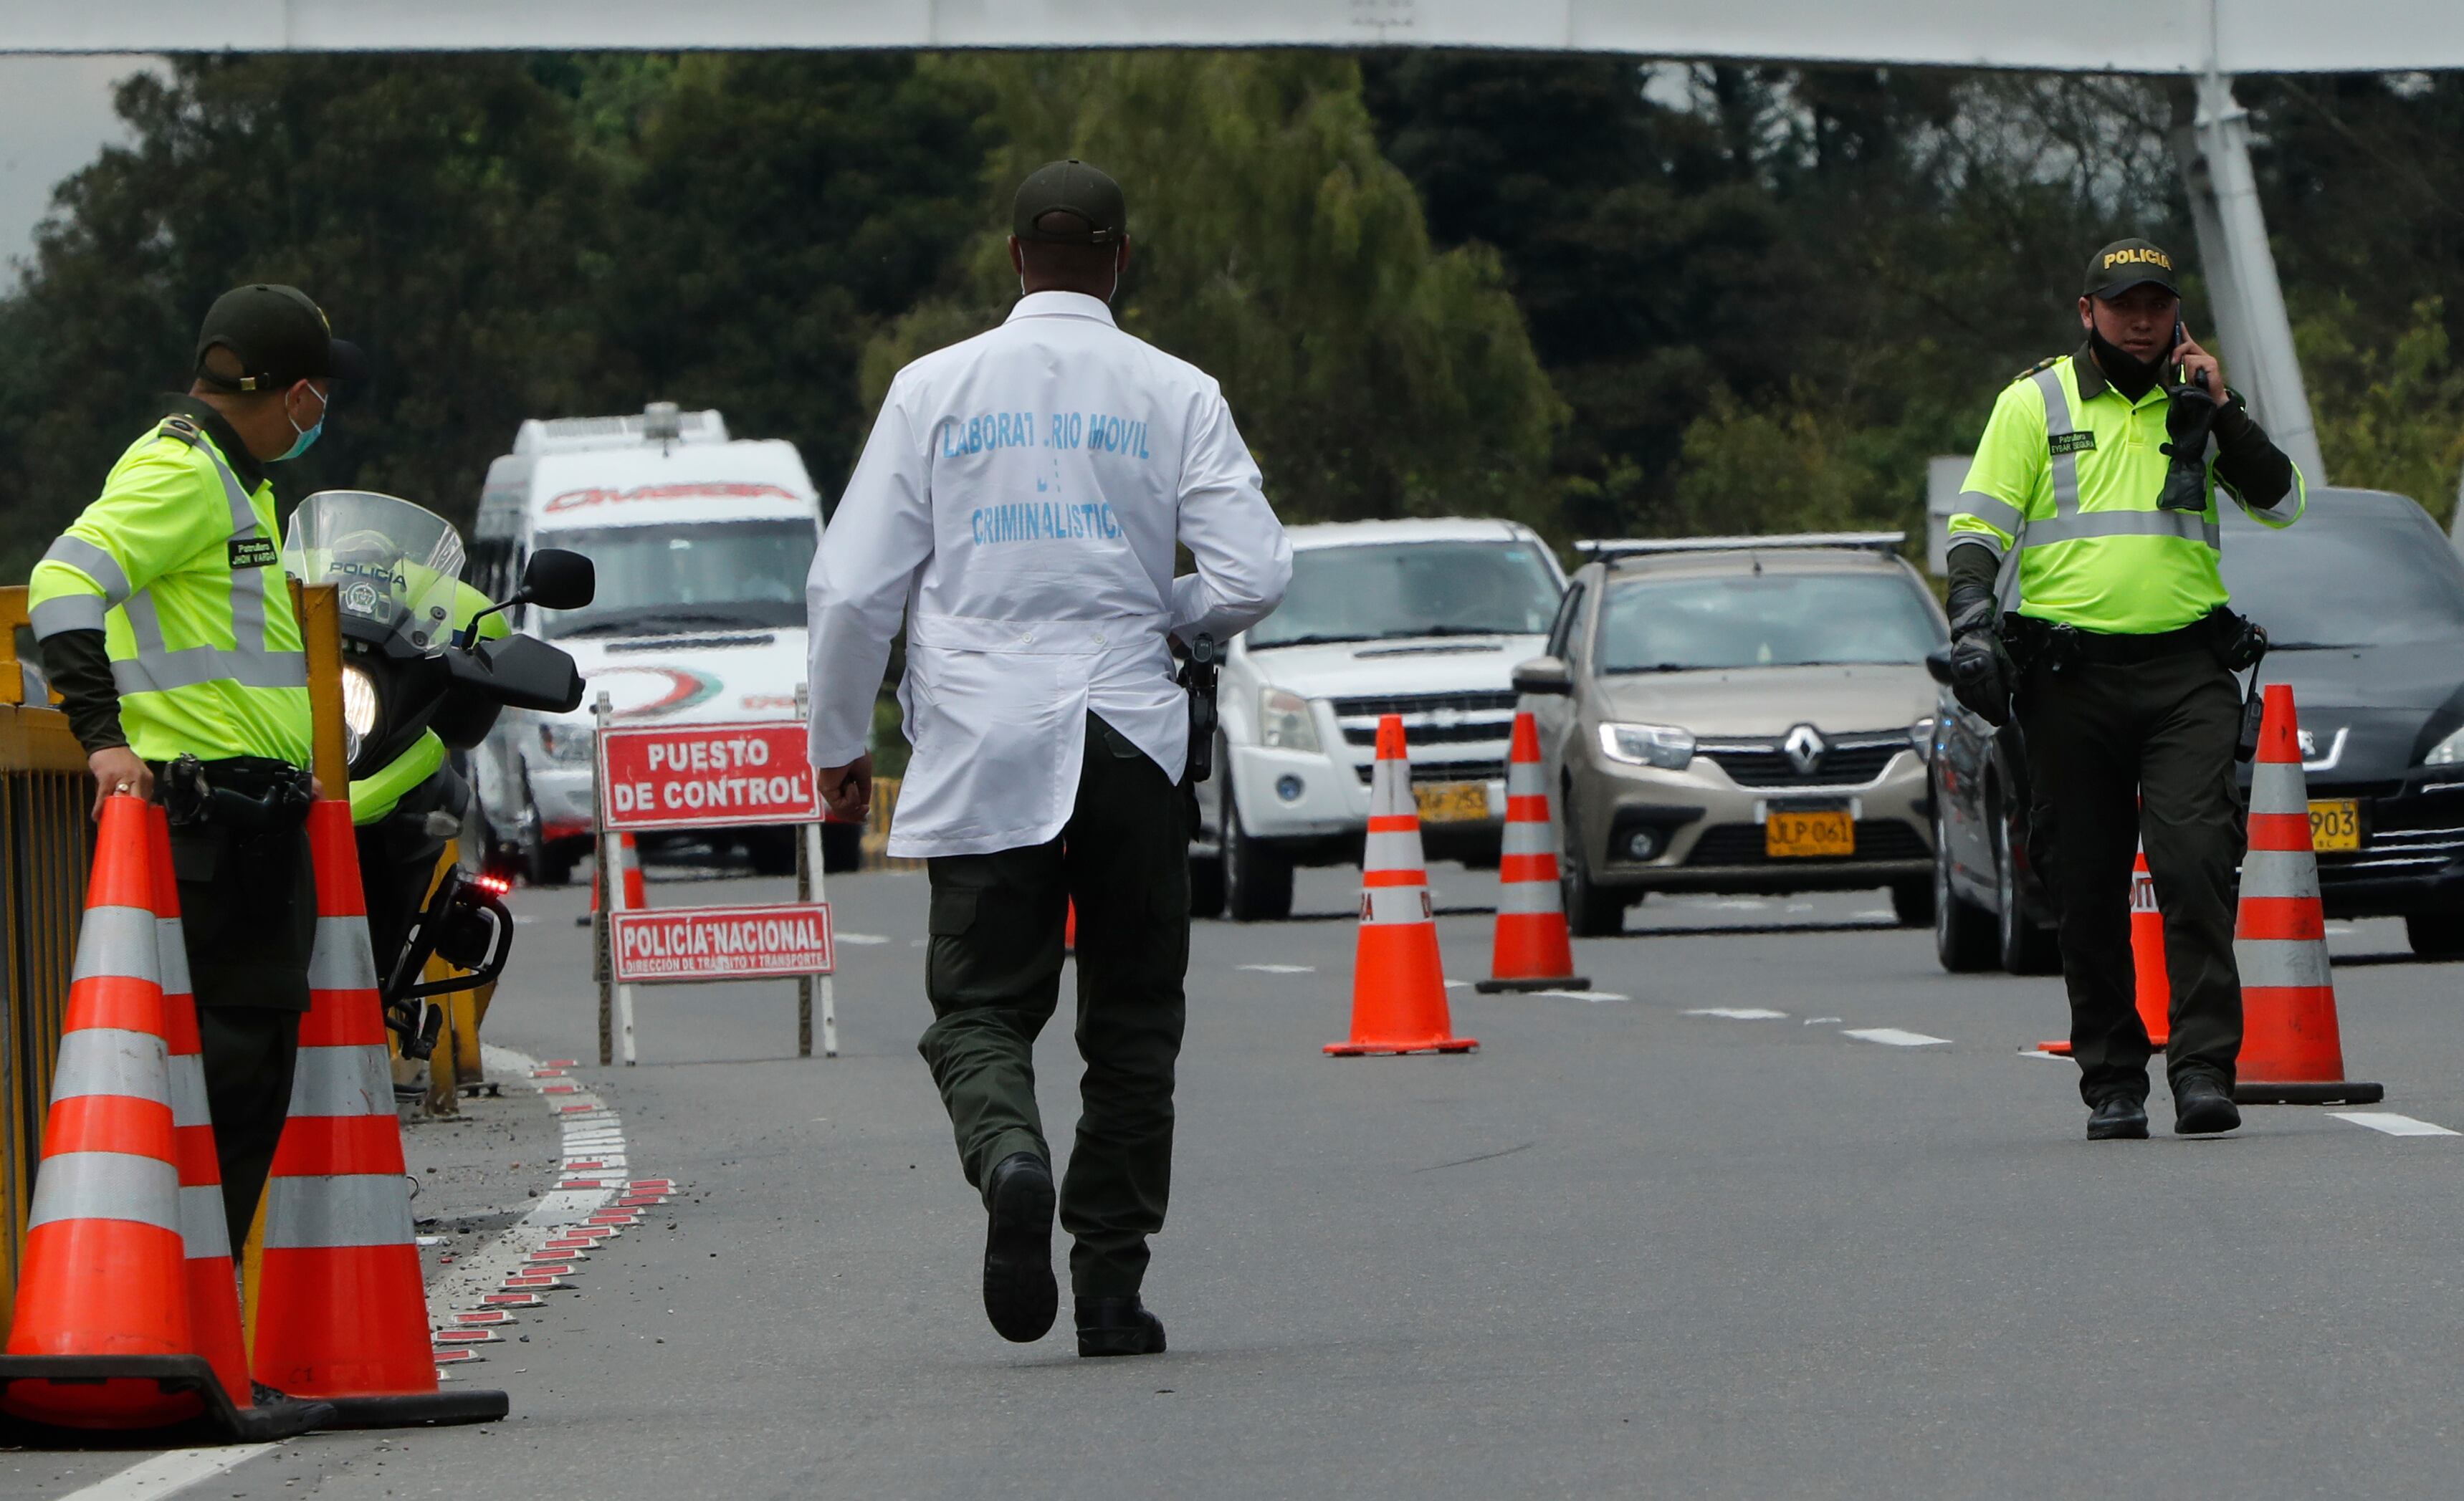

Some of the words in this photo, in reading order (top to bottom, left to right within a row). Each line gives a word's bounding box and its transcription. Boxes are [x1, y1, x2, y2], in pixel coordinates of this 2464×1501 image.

[2104, 249, 2172, 271] POLICIA
[943, 411, 1082, 459] LABORATRIO
[1089, 413, 1150, 459] MOVIL
[972, 502, 1124, 546] CRIMINALISTIC
[648, 738, 769, 771] PUESTO
[614, 782, 654, 812] DE
[663, 776, 809, 809] CONTROL
[2310, 811, 2354, 837] 903
[623, 917, 709, 958] POLICÍA
[714, 919, 822, 954] NACIONAL
[682, 956, 694, 970] DE
[748, 954, 757, 968] Y
[760, 951, 822, 969] TRANSPORTE
